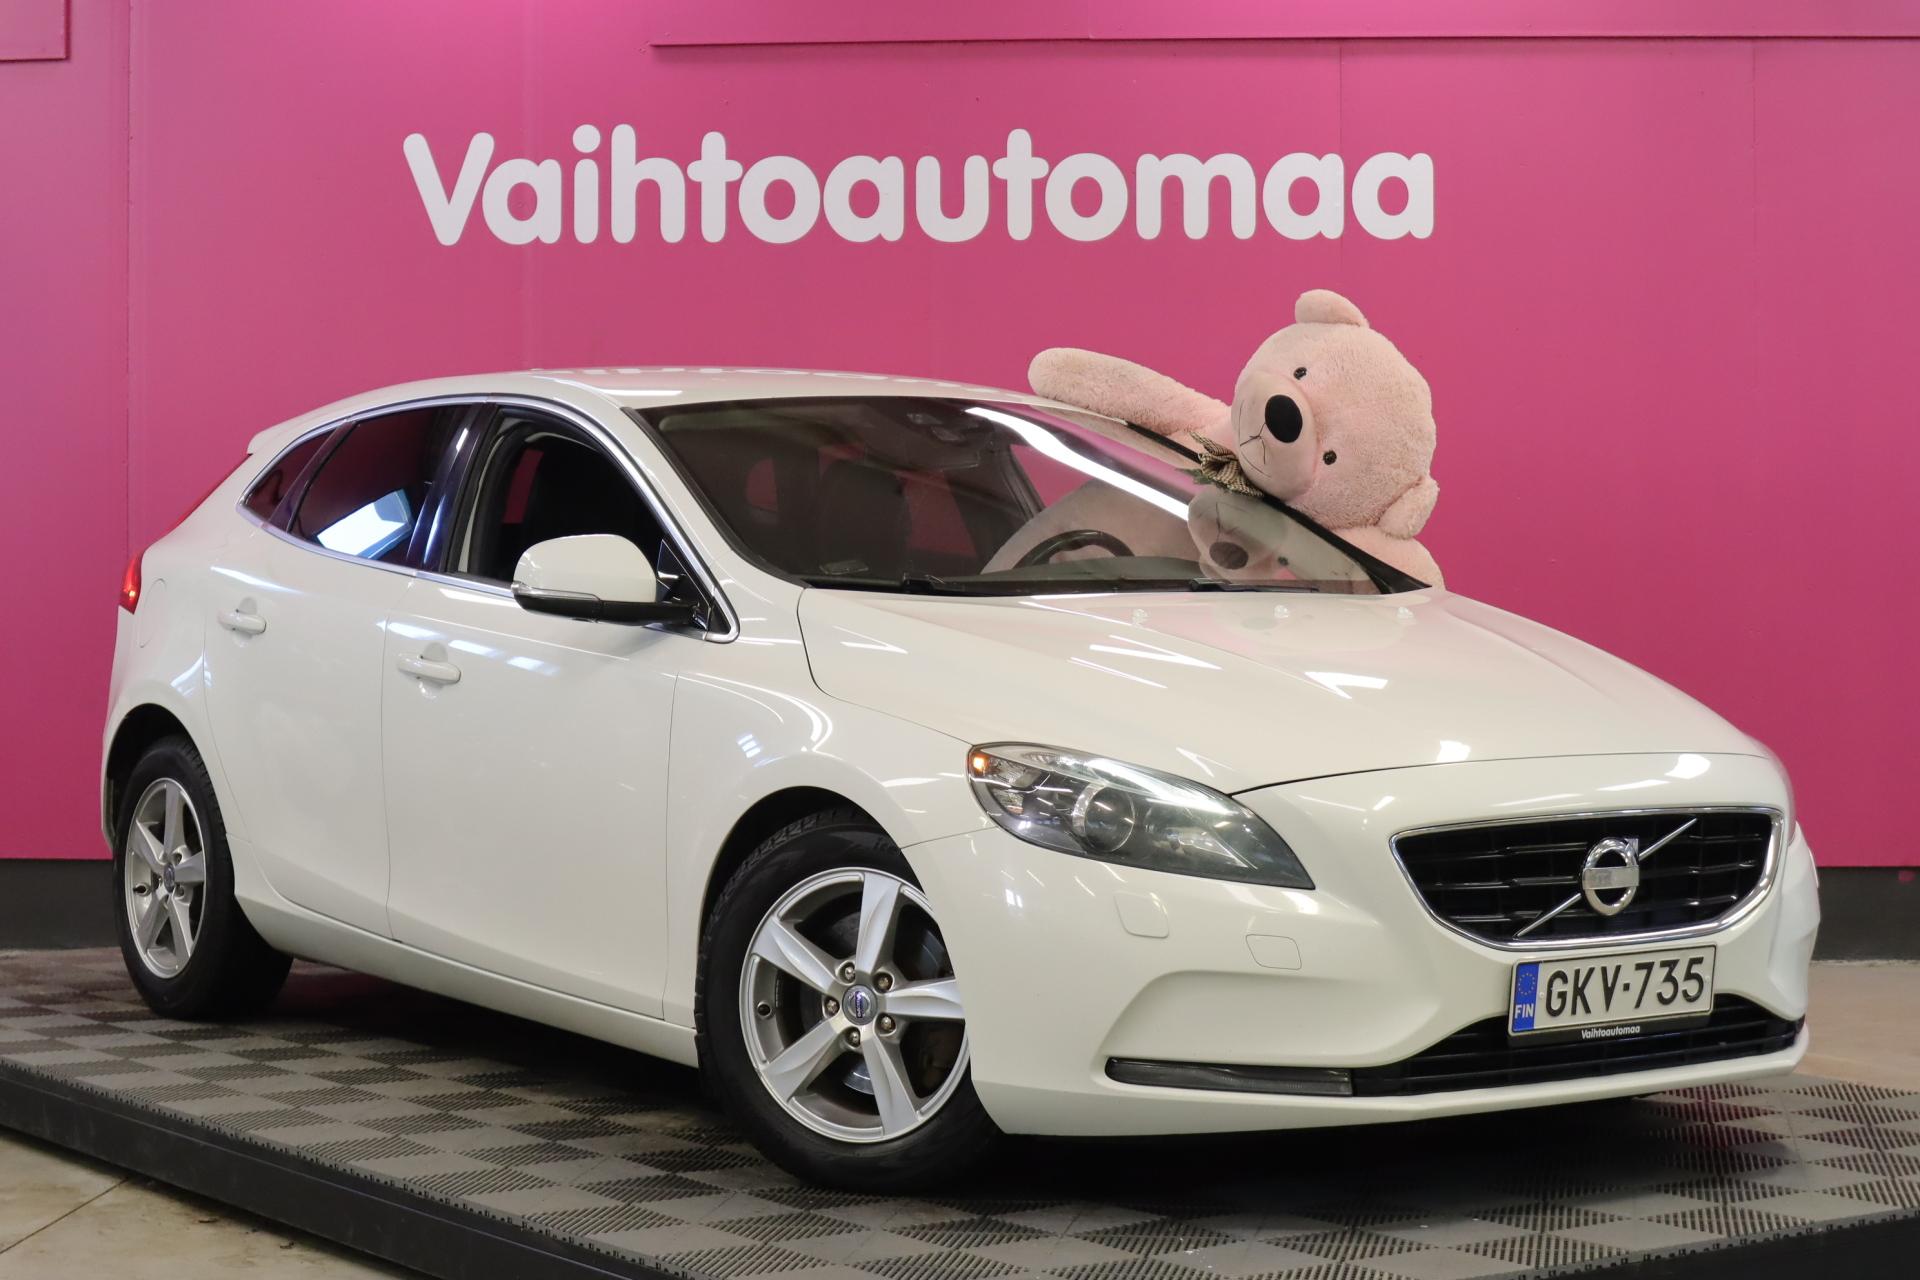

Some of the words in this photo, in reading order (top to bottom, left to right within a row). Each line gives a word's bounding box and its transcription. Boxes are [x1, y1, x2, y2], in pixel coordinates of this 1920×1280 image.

[403, 124, 1435, 245] Vaihtoautomaa
[1514, 1003, 1534, 1018] FIN
[1581, 1025, 1641, 1039] Vaihtoautomaa
